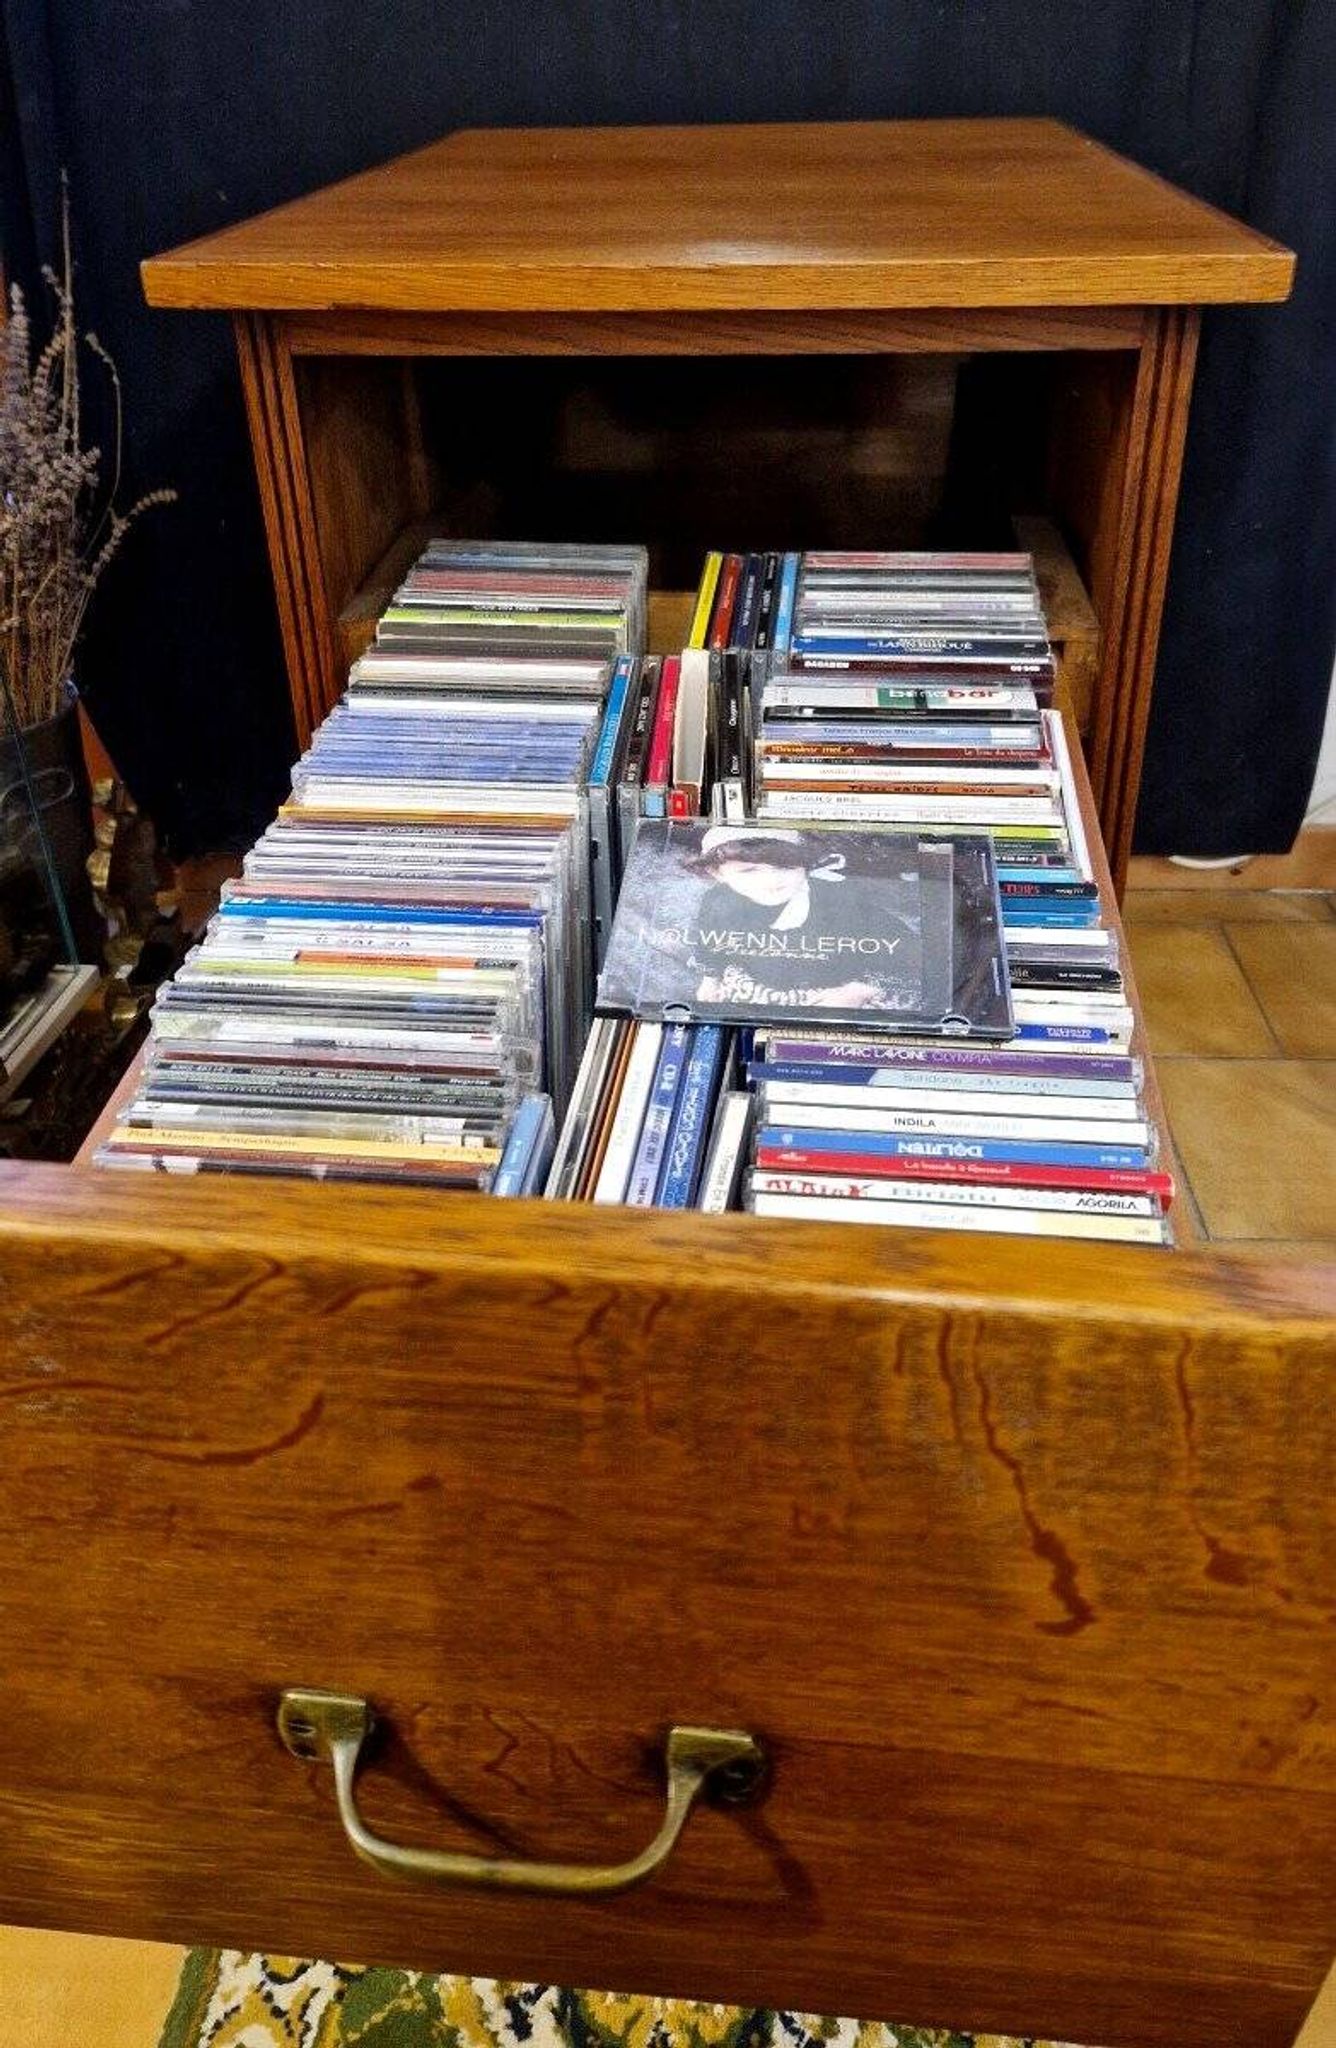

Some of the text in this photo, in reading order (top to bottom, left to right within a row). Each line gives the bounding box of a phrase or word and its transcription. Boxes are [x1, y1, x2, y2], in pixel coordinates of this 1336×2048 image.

[638, 927, 901, 955] NOLWENN LEROY
[893, 1116, 936, 1128] INDILA
[1075, 1197, 1138, 1211] AGORILA
